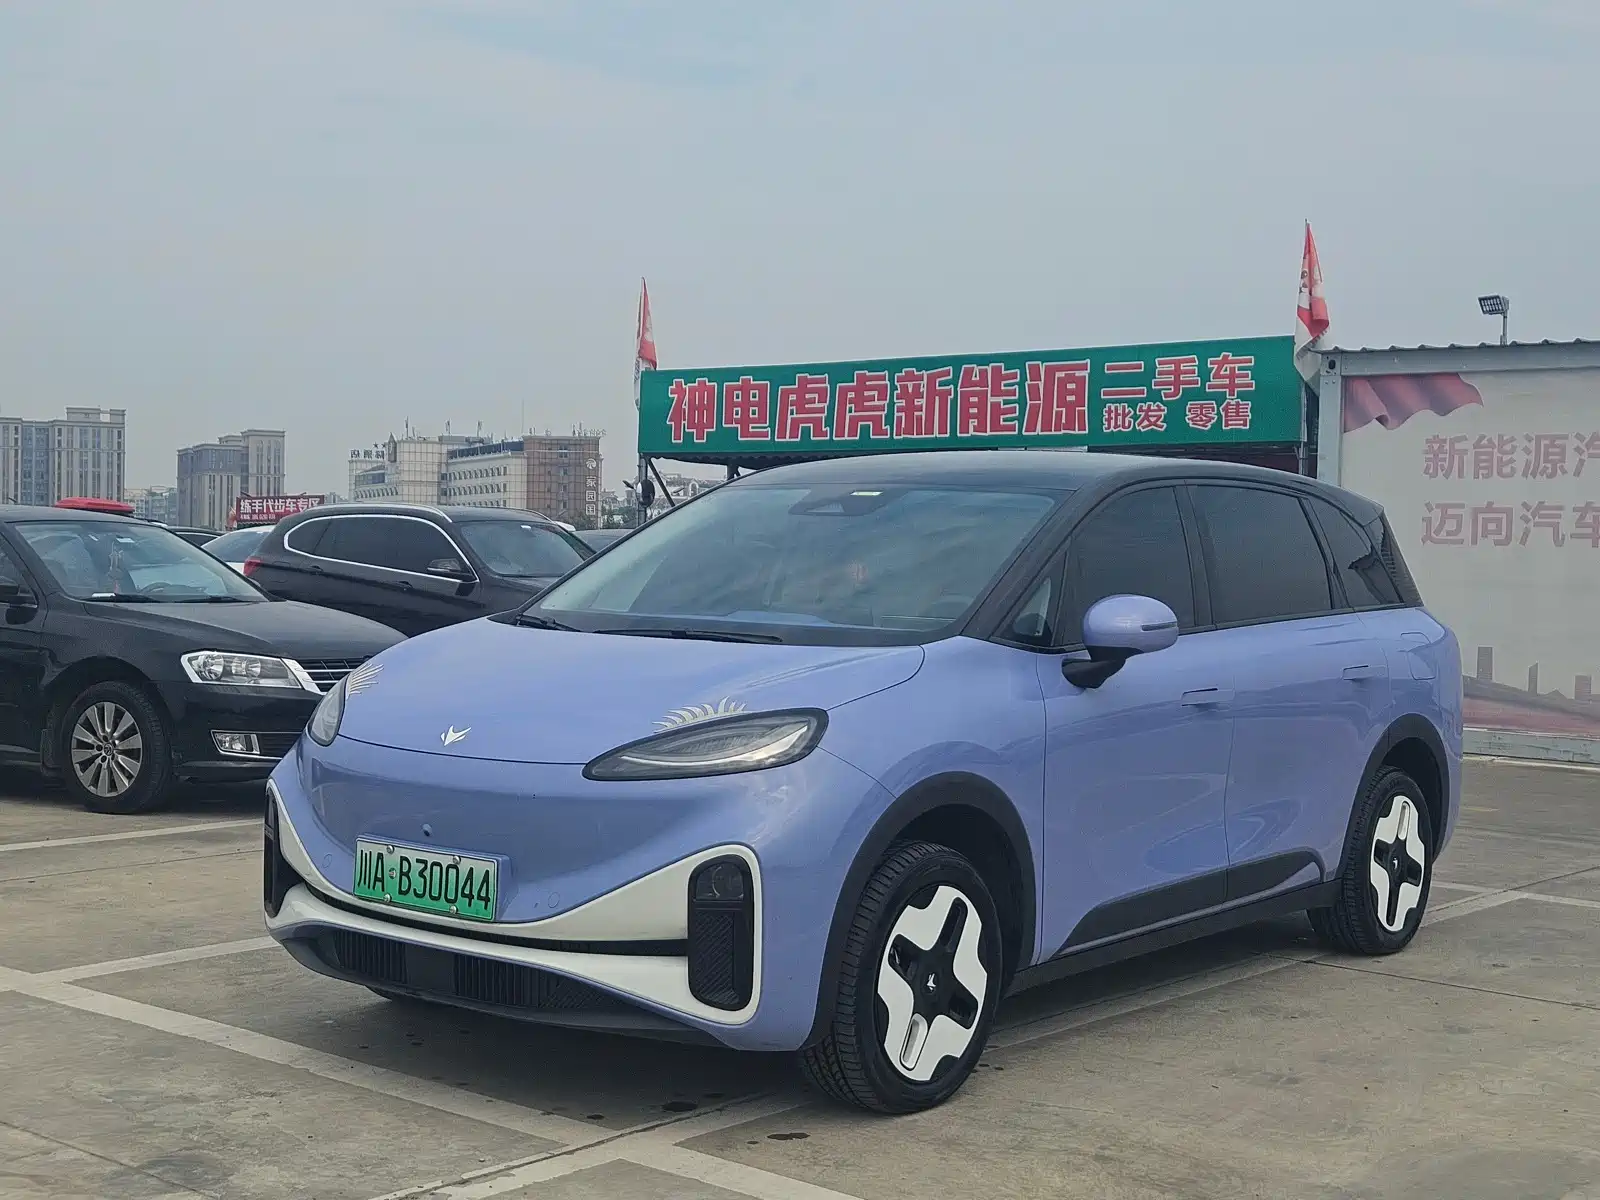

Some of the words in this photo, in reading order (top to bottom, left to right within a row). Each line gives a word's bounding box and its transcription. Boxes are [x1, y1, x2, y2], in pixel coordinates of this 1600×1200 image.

[667, 359, 1090, 443] 神电虎虎新能源
[1101, 352, 1255, 400] 二手车
[1102, 401, 1167, 432] 批发
[1185, 400, 1253, 431] 零售
[1420, 500, 1600, 548] 迈向汽车
